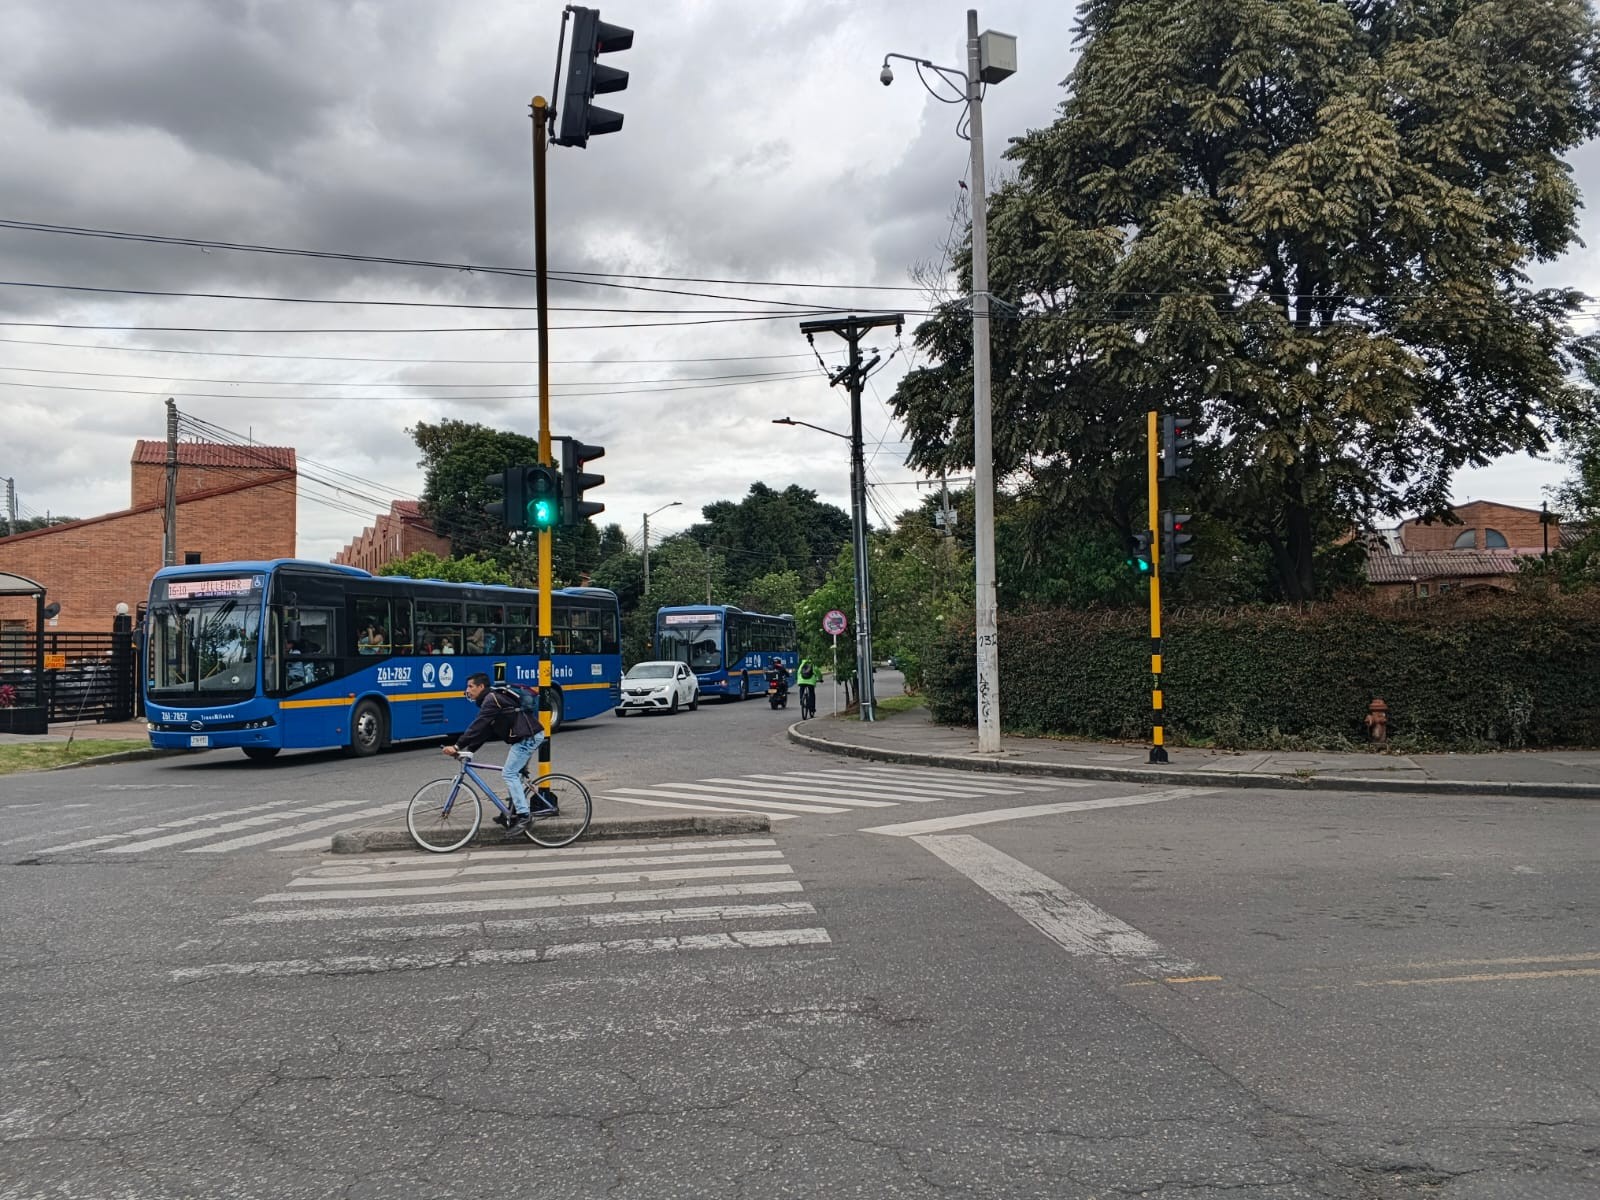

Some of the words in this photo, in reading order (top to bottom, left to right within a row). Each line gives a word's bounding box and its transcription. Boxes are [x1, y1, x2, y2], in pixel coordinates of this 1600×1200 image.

[200, 580, 242, 592] VILLEMAR
[377, 667, 412, 681] Z61-7857
[516, 664, 573, 680] Tranlenio
